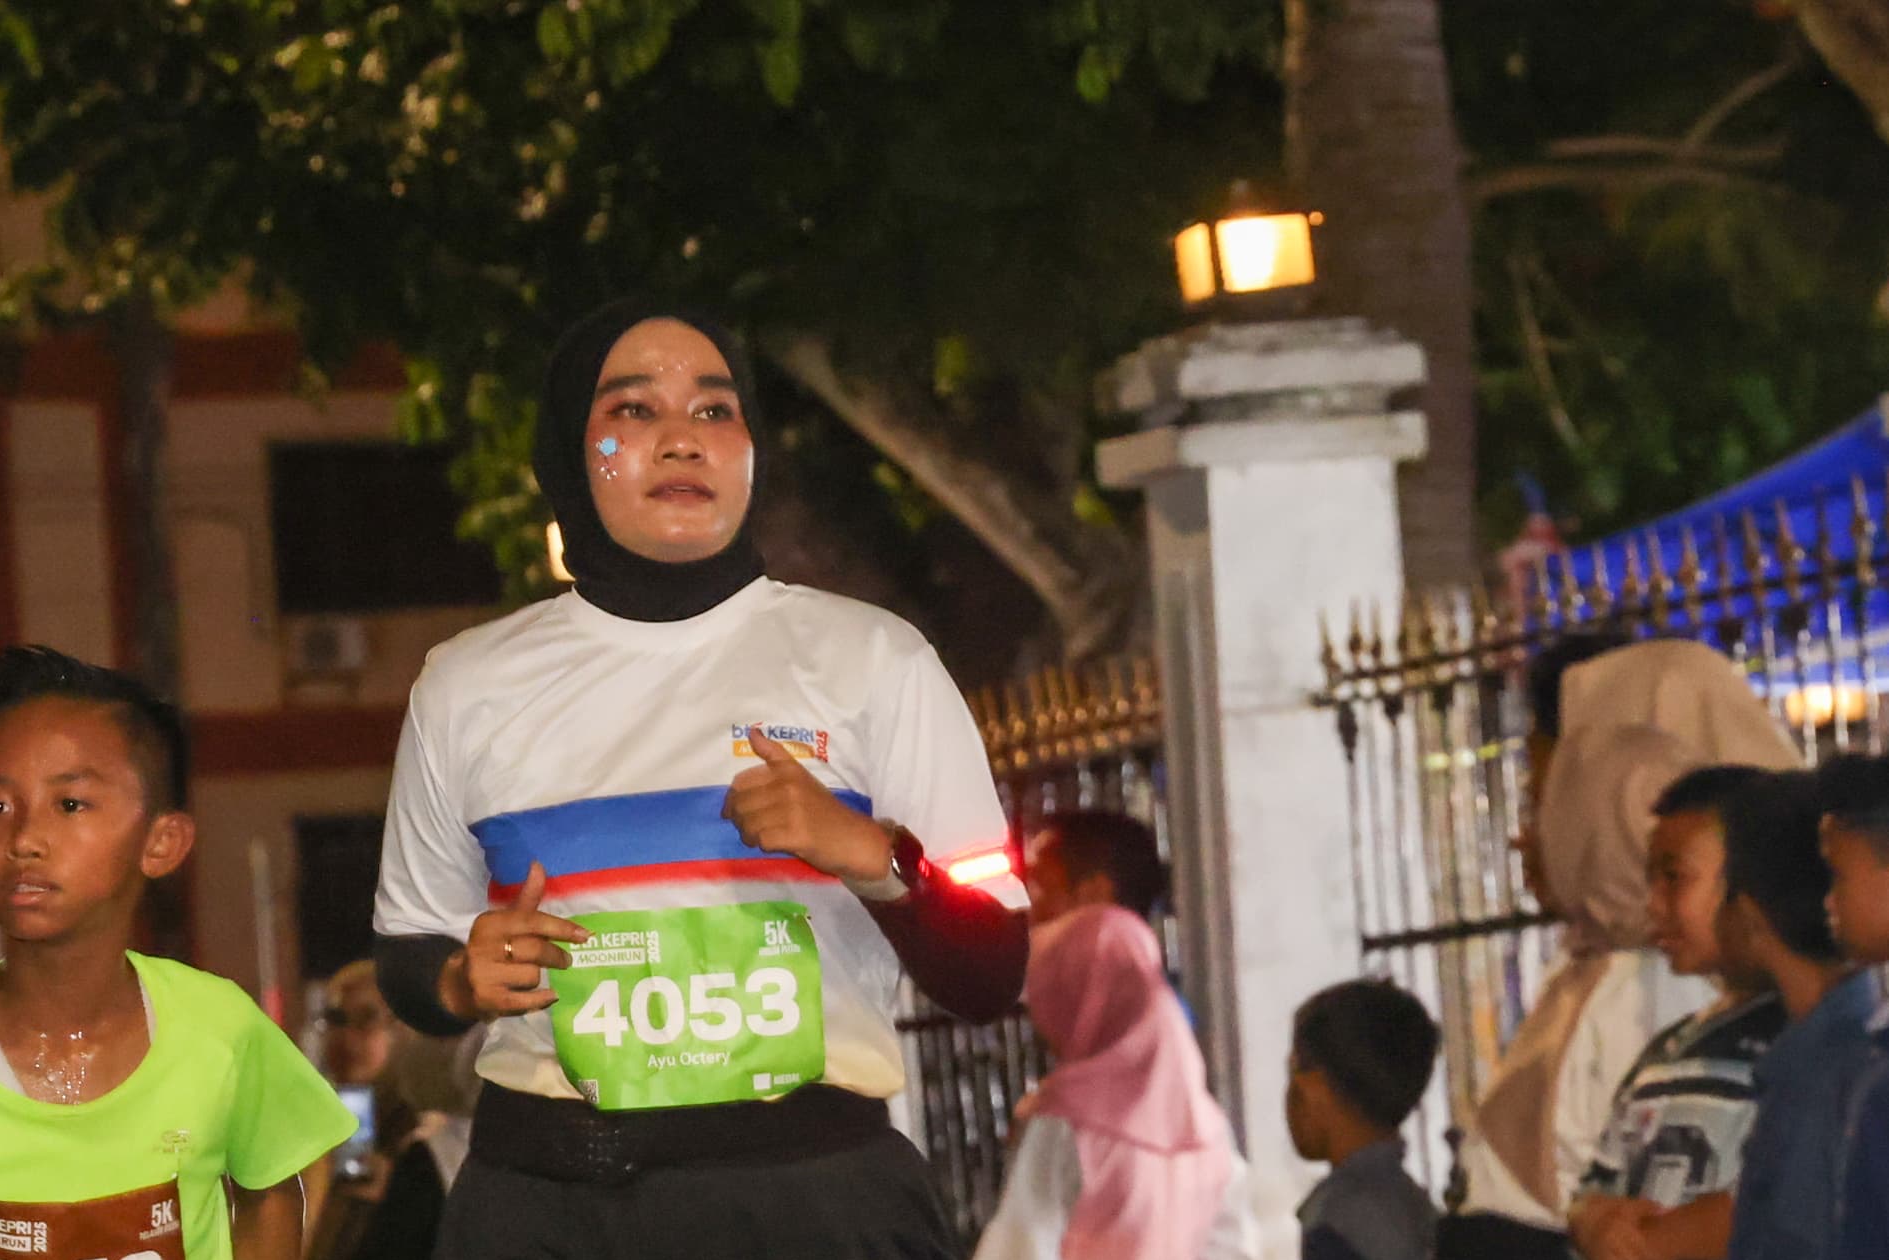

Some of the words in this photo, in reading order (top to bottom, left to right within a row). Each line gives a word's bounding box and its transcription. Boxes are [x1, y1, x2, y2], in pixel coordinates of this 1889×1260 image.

[732, 724, 764, 739] bt
[767, 726, 814, 742] KEPRI
[601, 932, 645, 948] KEPRI
[764, 920, 792, 945] 5K
[573, 967, 801, 1046] 4053
[647, 1054, 676, 1069] Ayu
[680, 1051, 731, 1066] Octery
[151, 1199, 174, 1228] 5K
[33, 1221, 48, 1253] 2025
